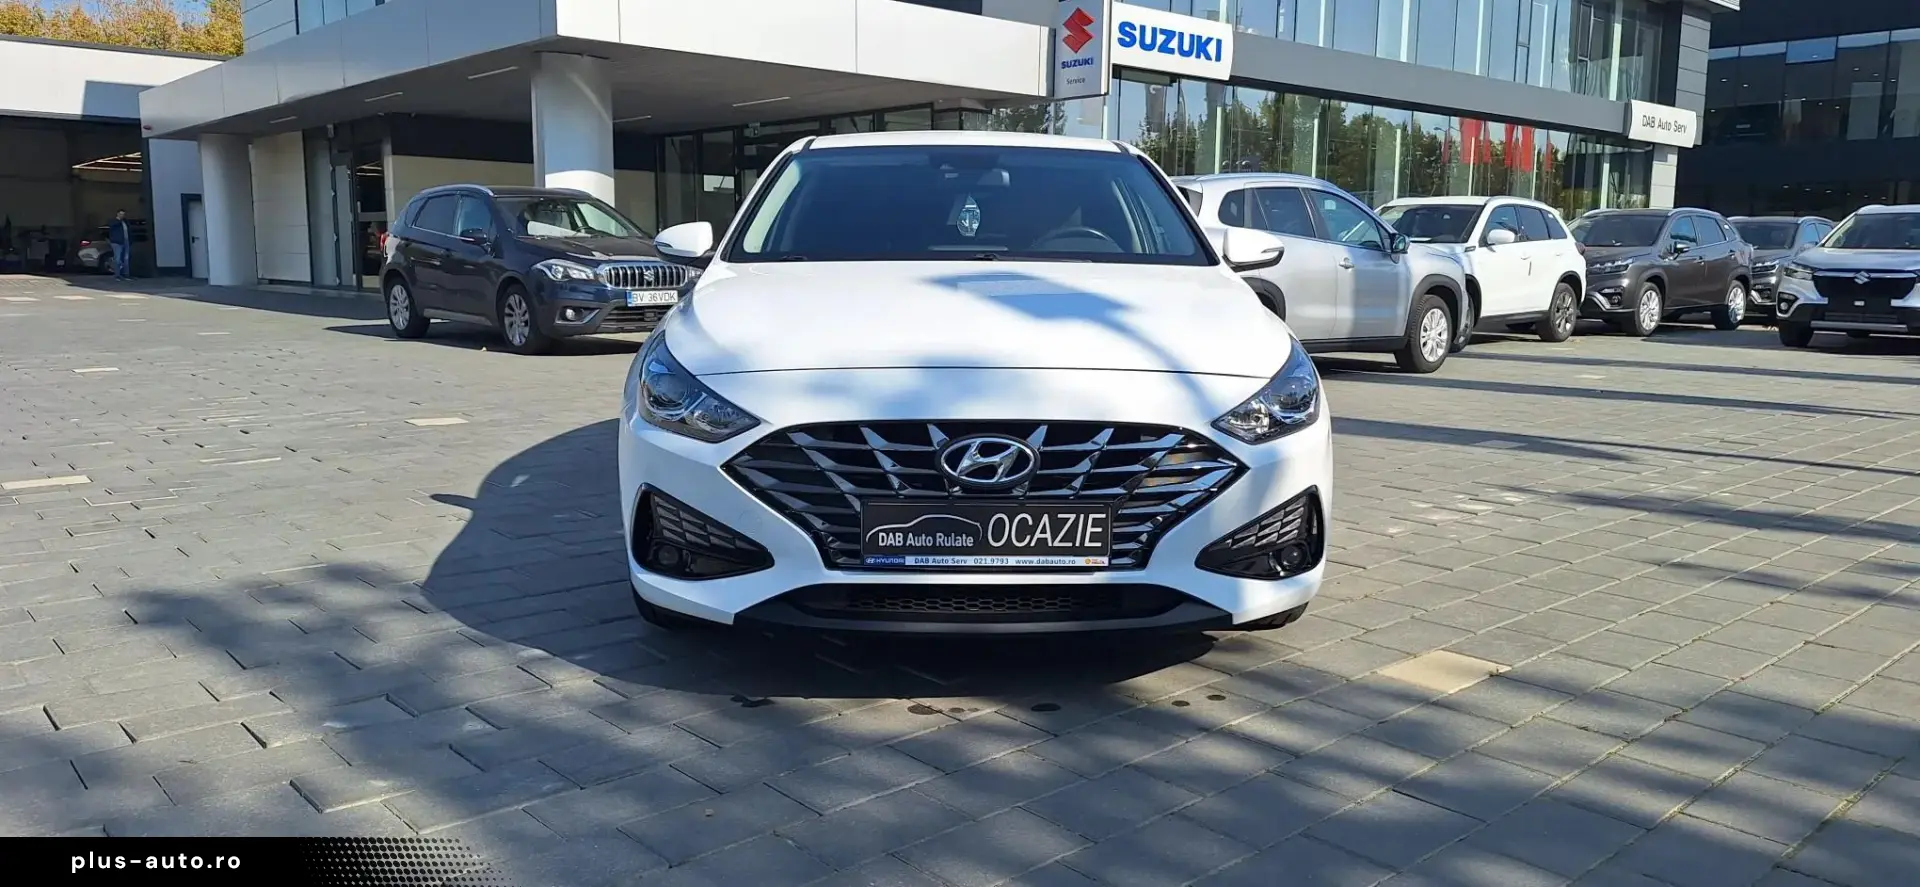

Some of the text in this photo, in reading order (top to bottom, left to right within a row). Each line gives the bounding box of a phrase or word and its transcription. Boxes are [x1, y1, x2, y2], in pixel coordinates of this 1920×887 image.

[1117, 21, 1222, 62] SUZUKI
[1061, 57, 1094, 69] SUZUKI
[1066, 77, 1086, 85] Service
[1642, 114, 1687, 134] DAB Auto Serv
[632, 292, 644, 302] BV
[987, 512, 1107, 547] OCAZIE
[878, 532, 974, 547] DAB Auto Rulate
[914, 557, 1076, 565] DAB Auto Serv 021.9793 www.dabauto.ro
